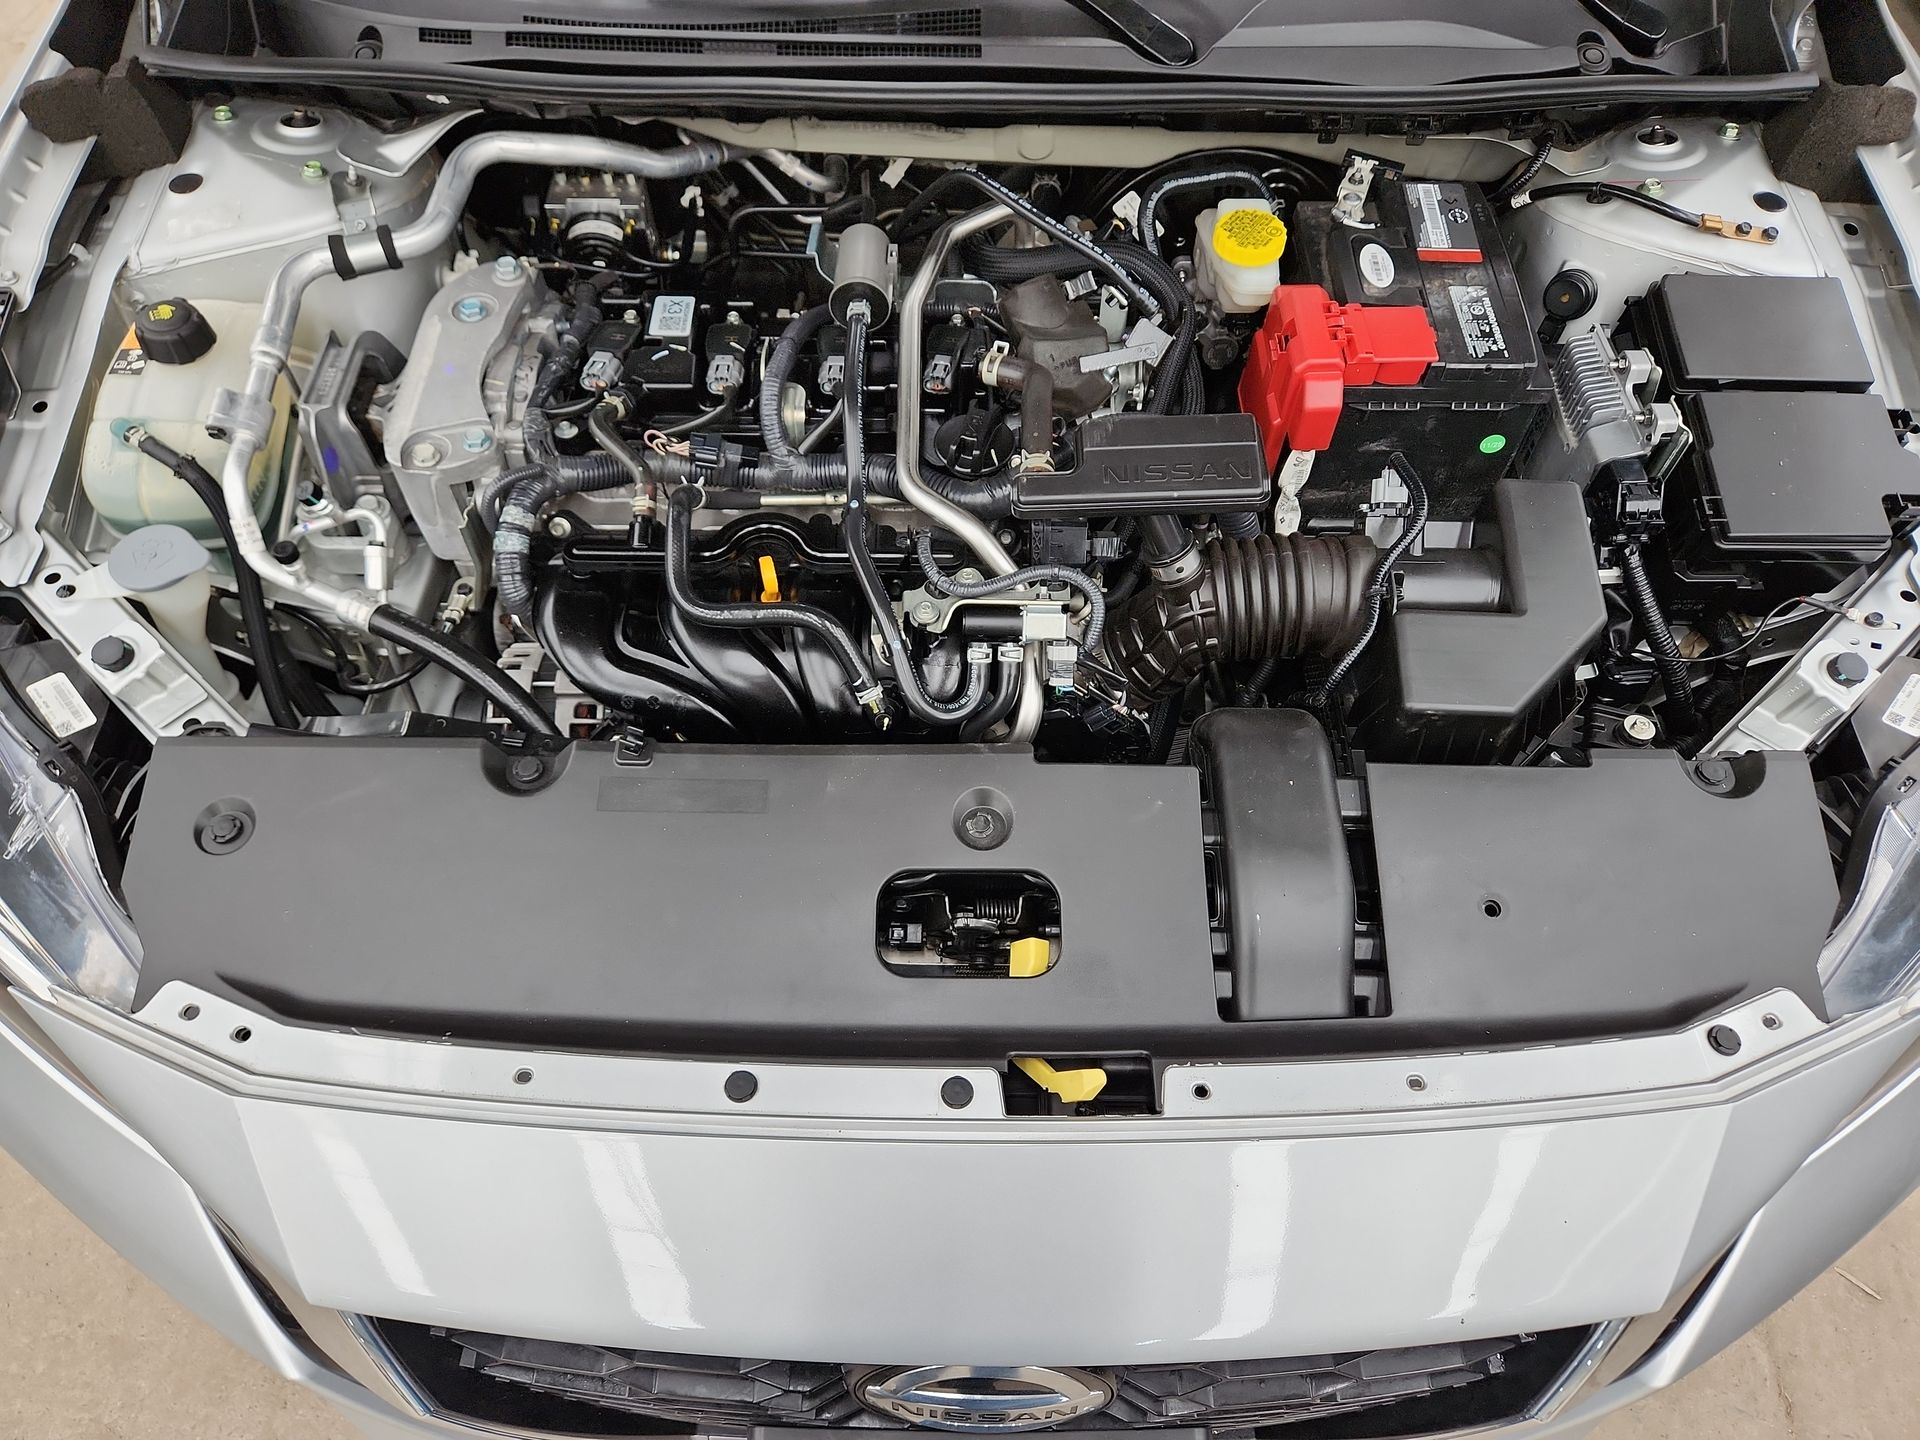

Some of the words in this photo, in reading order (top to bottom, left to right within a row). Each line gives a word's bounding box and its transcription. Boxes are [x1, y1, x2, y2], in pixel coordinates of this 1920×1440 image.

[668, 299, 683, 314] X3
[1102, 463, 1252, 484] NISSAN
[891, 1401, 1079, 1423] NISSAN
